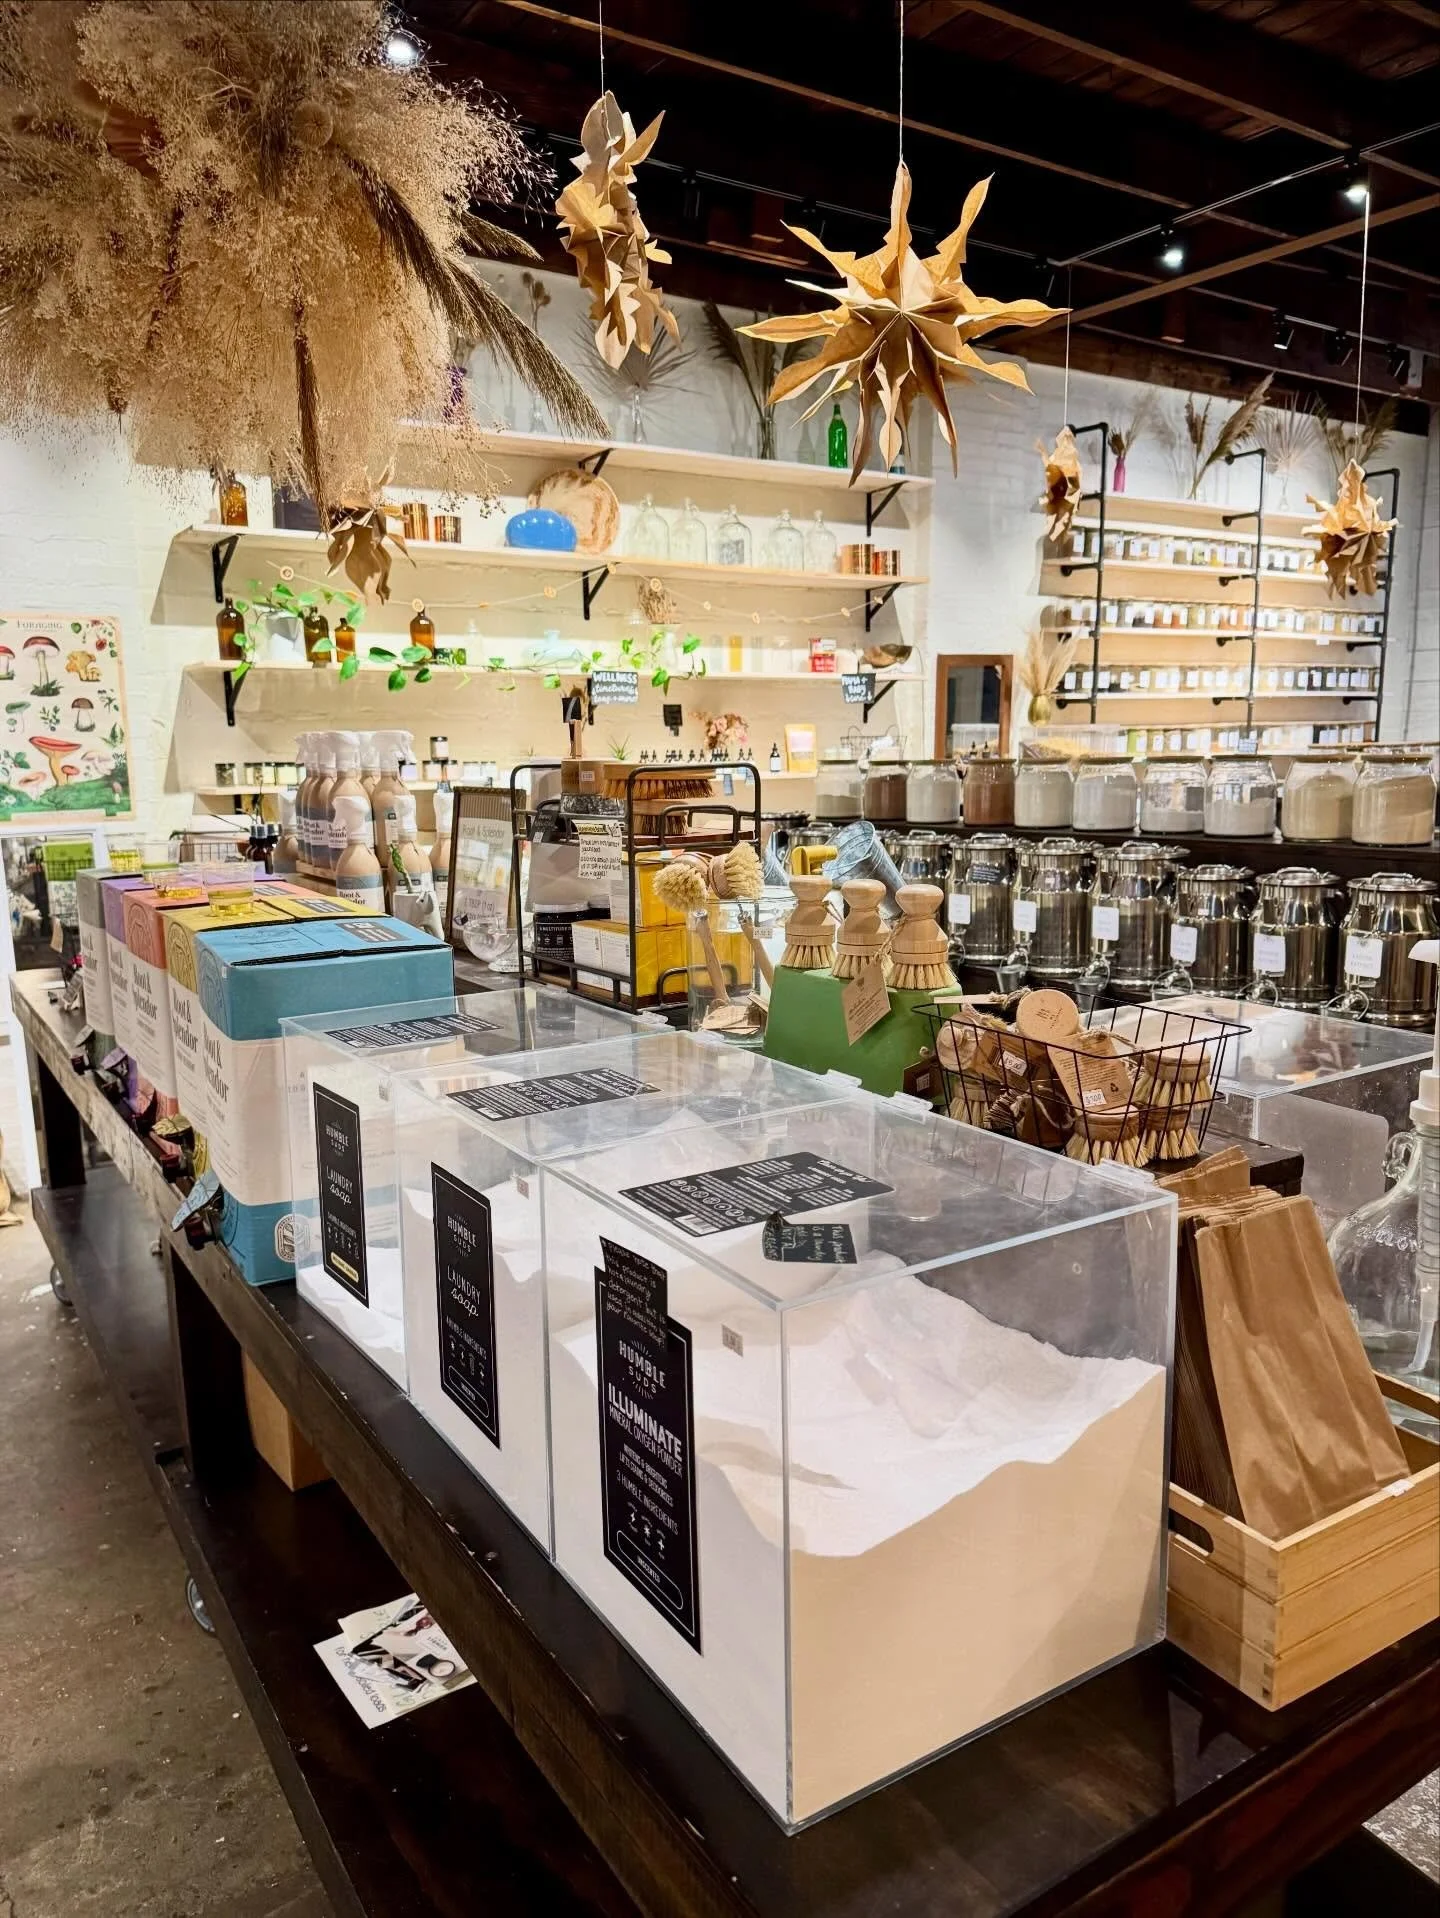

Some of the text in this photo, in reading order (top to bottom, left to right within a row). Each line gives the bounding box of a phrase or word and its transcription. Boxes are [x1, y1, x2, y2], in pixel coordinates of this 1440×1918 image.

[592, 672, 637, 684] WELLNESS
[326, 1165, 353, 1194] LAUNDRY
[447, 1215, 477, 1248] HUMBLE
[447, 1266, 481, 1305] LAUNDRY
[451, 1288, 480, 1318] soap
[619, 1340, 666, 1388] HUMBLE
[628, 1365, 657, 1393] SUDS
[608, 1382, 683, 1462] ILLUMINATE
[609, 1405, 683, 1480] MINERAL OXYGEN POWDER
[621, 1473, 643, 1503] HUMBLE
[643, 1495, 679, 1536] INGREDIENTS
